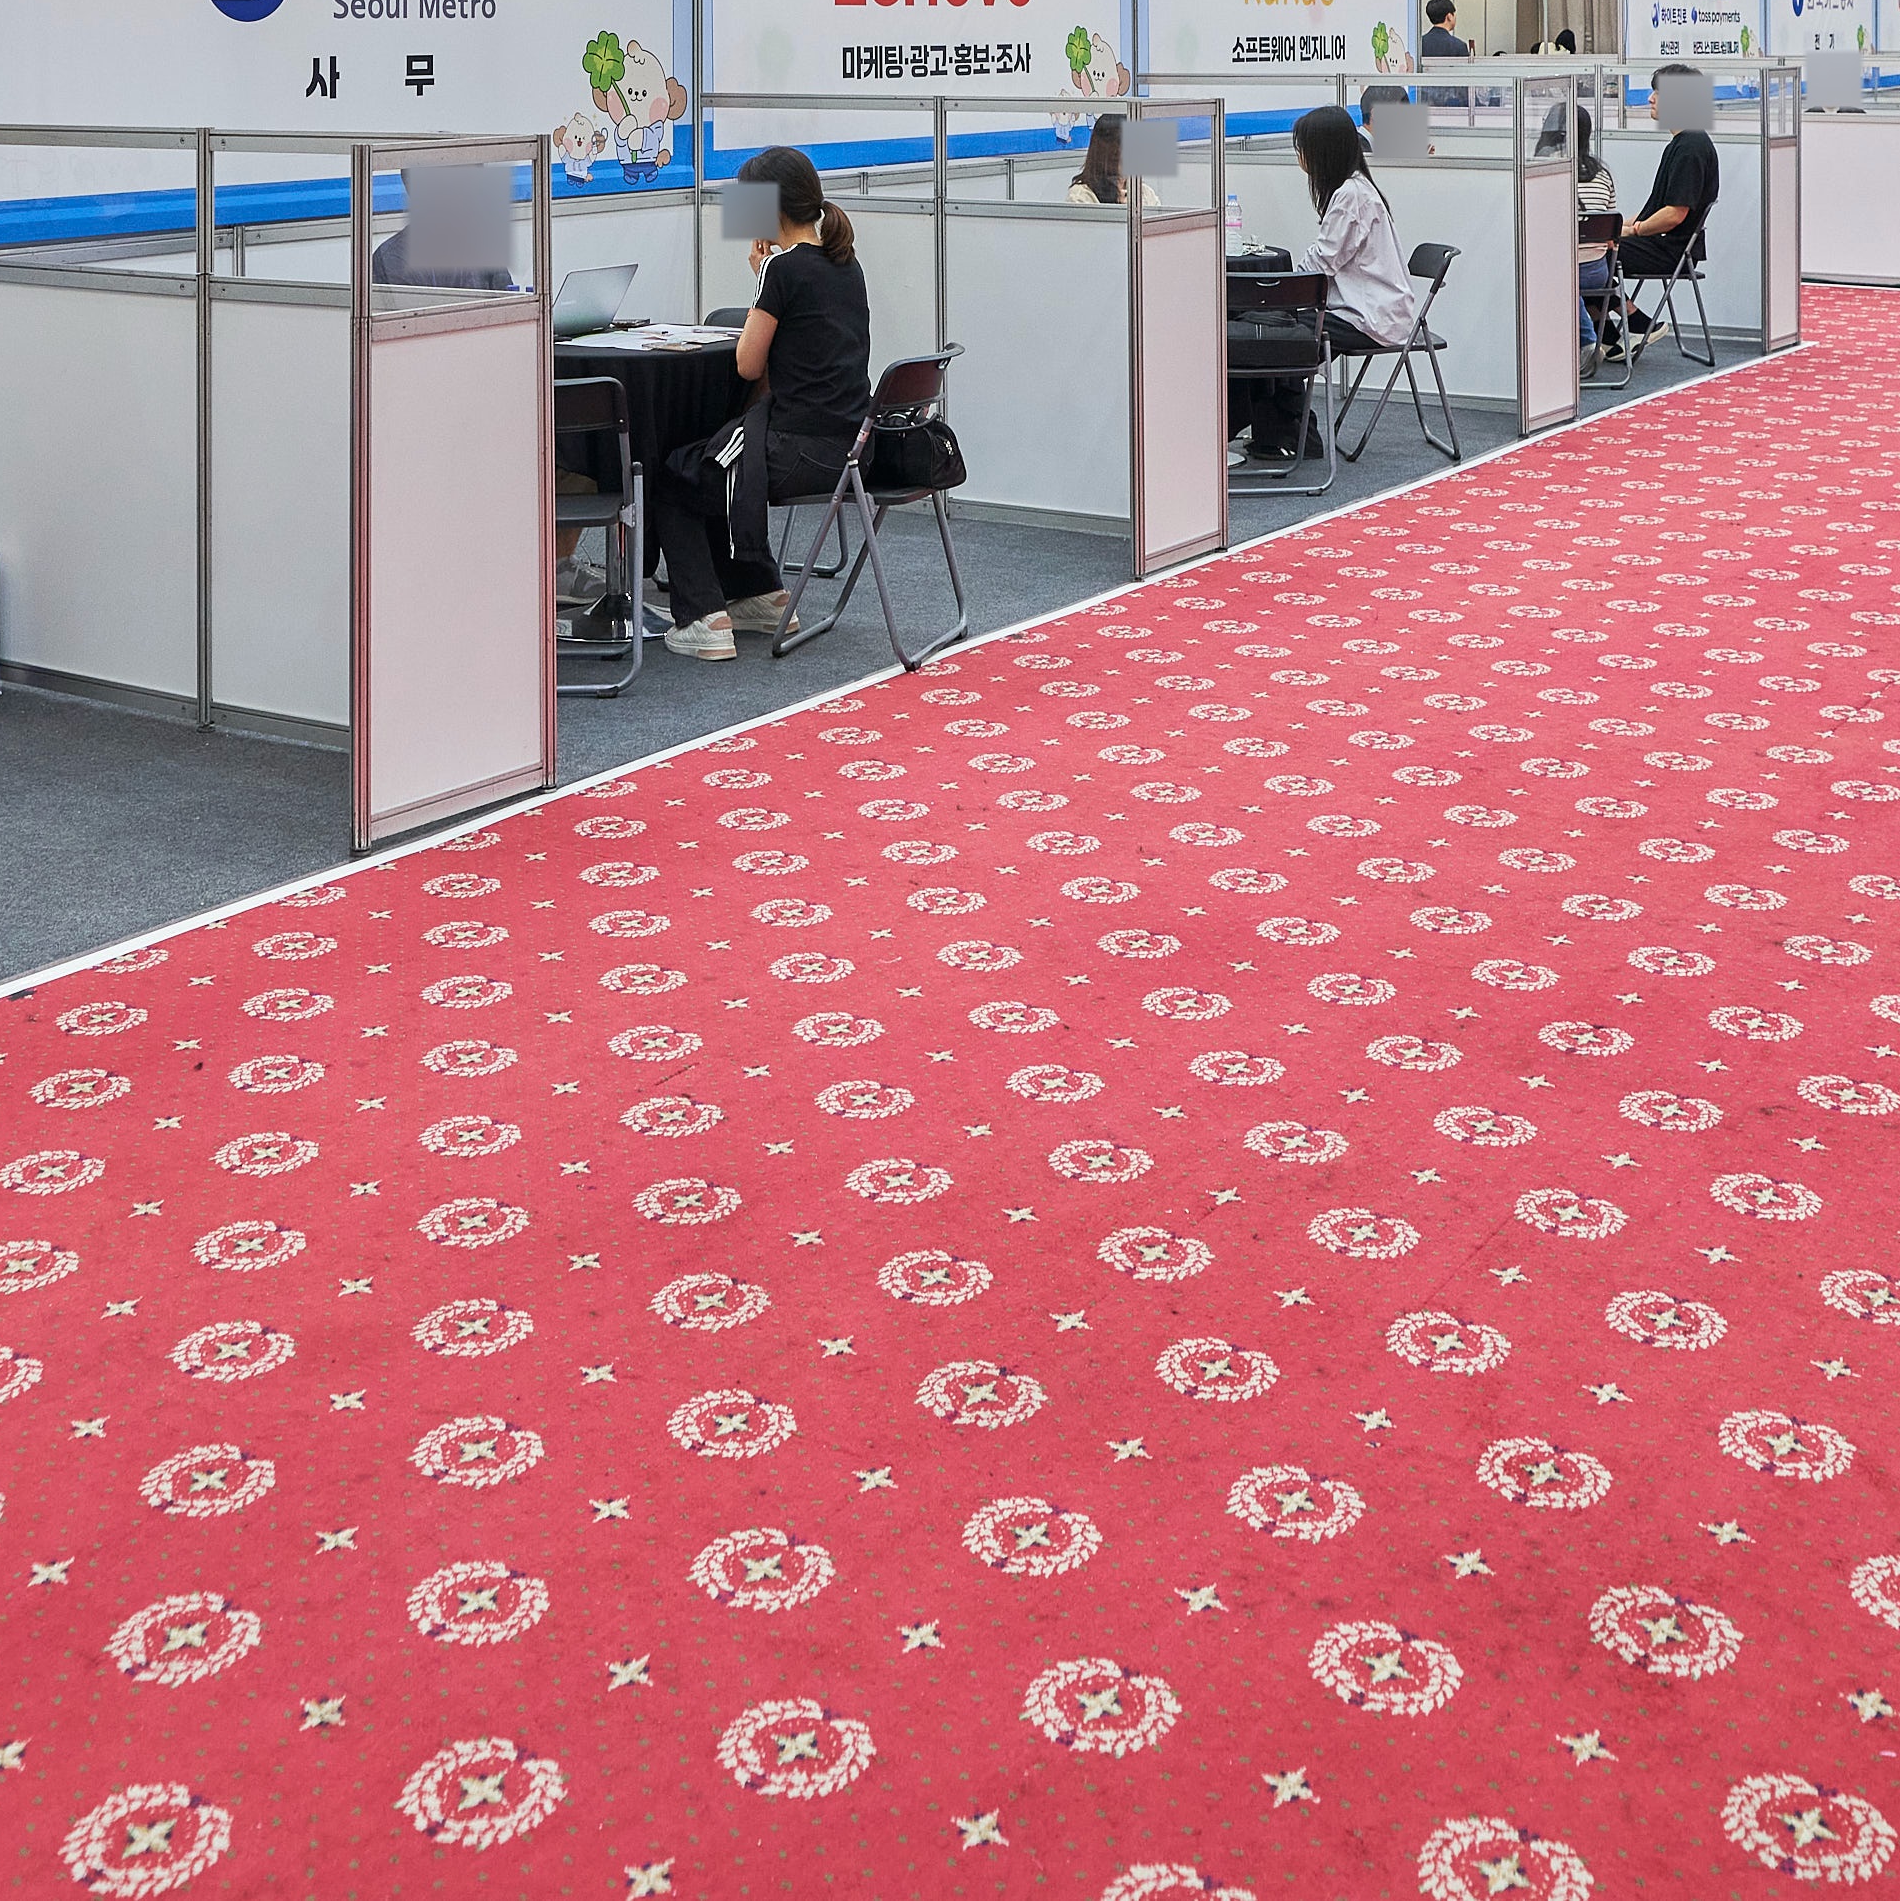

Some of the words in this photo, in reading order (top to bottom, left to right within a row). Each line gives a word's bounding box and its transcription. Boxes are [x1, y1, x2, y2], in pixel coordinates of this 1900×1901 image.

[1661, 7, 1687, 25] 하이트진로
[1232, 34, 1296, 65] 소프트웨어
[1298, 33, 1346, 63] 엔지니어
[305, 56, 340, 99] 사
[404, 55, 435, 97] 무
